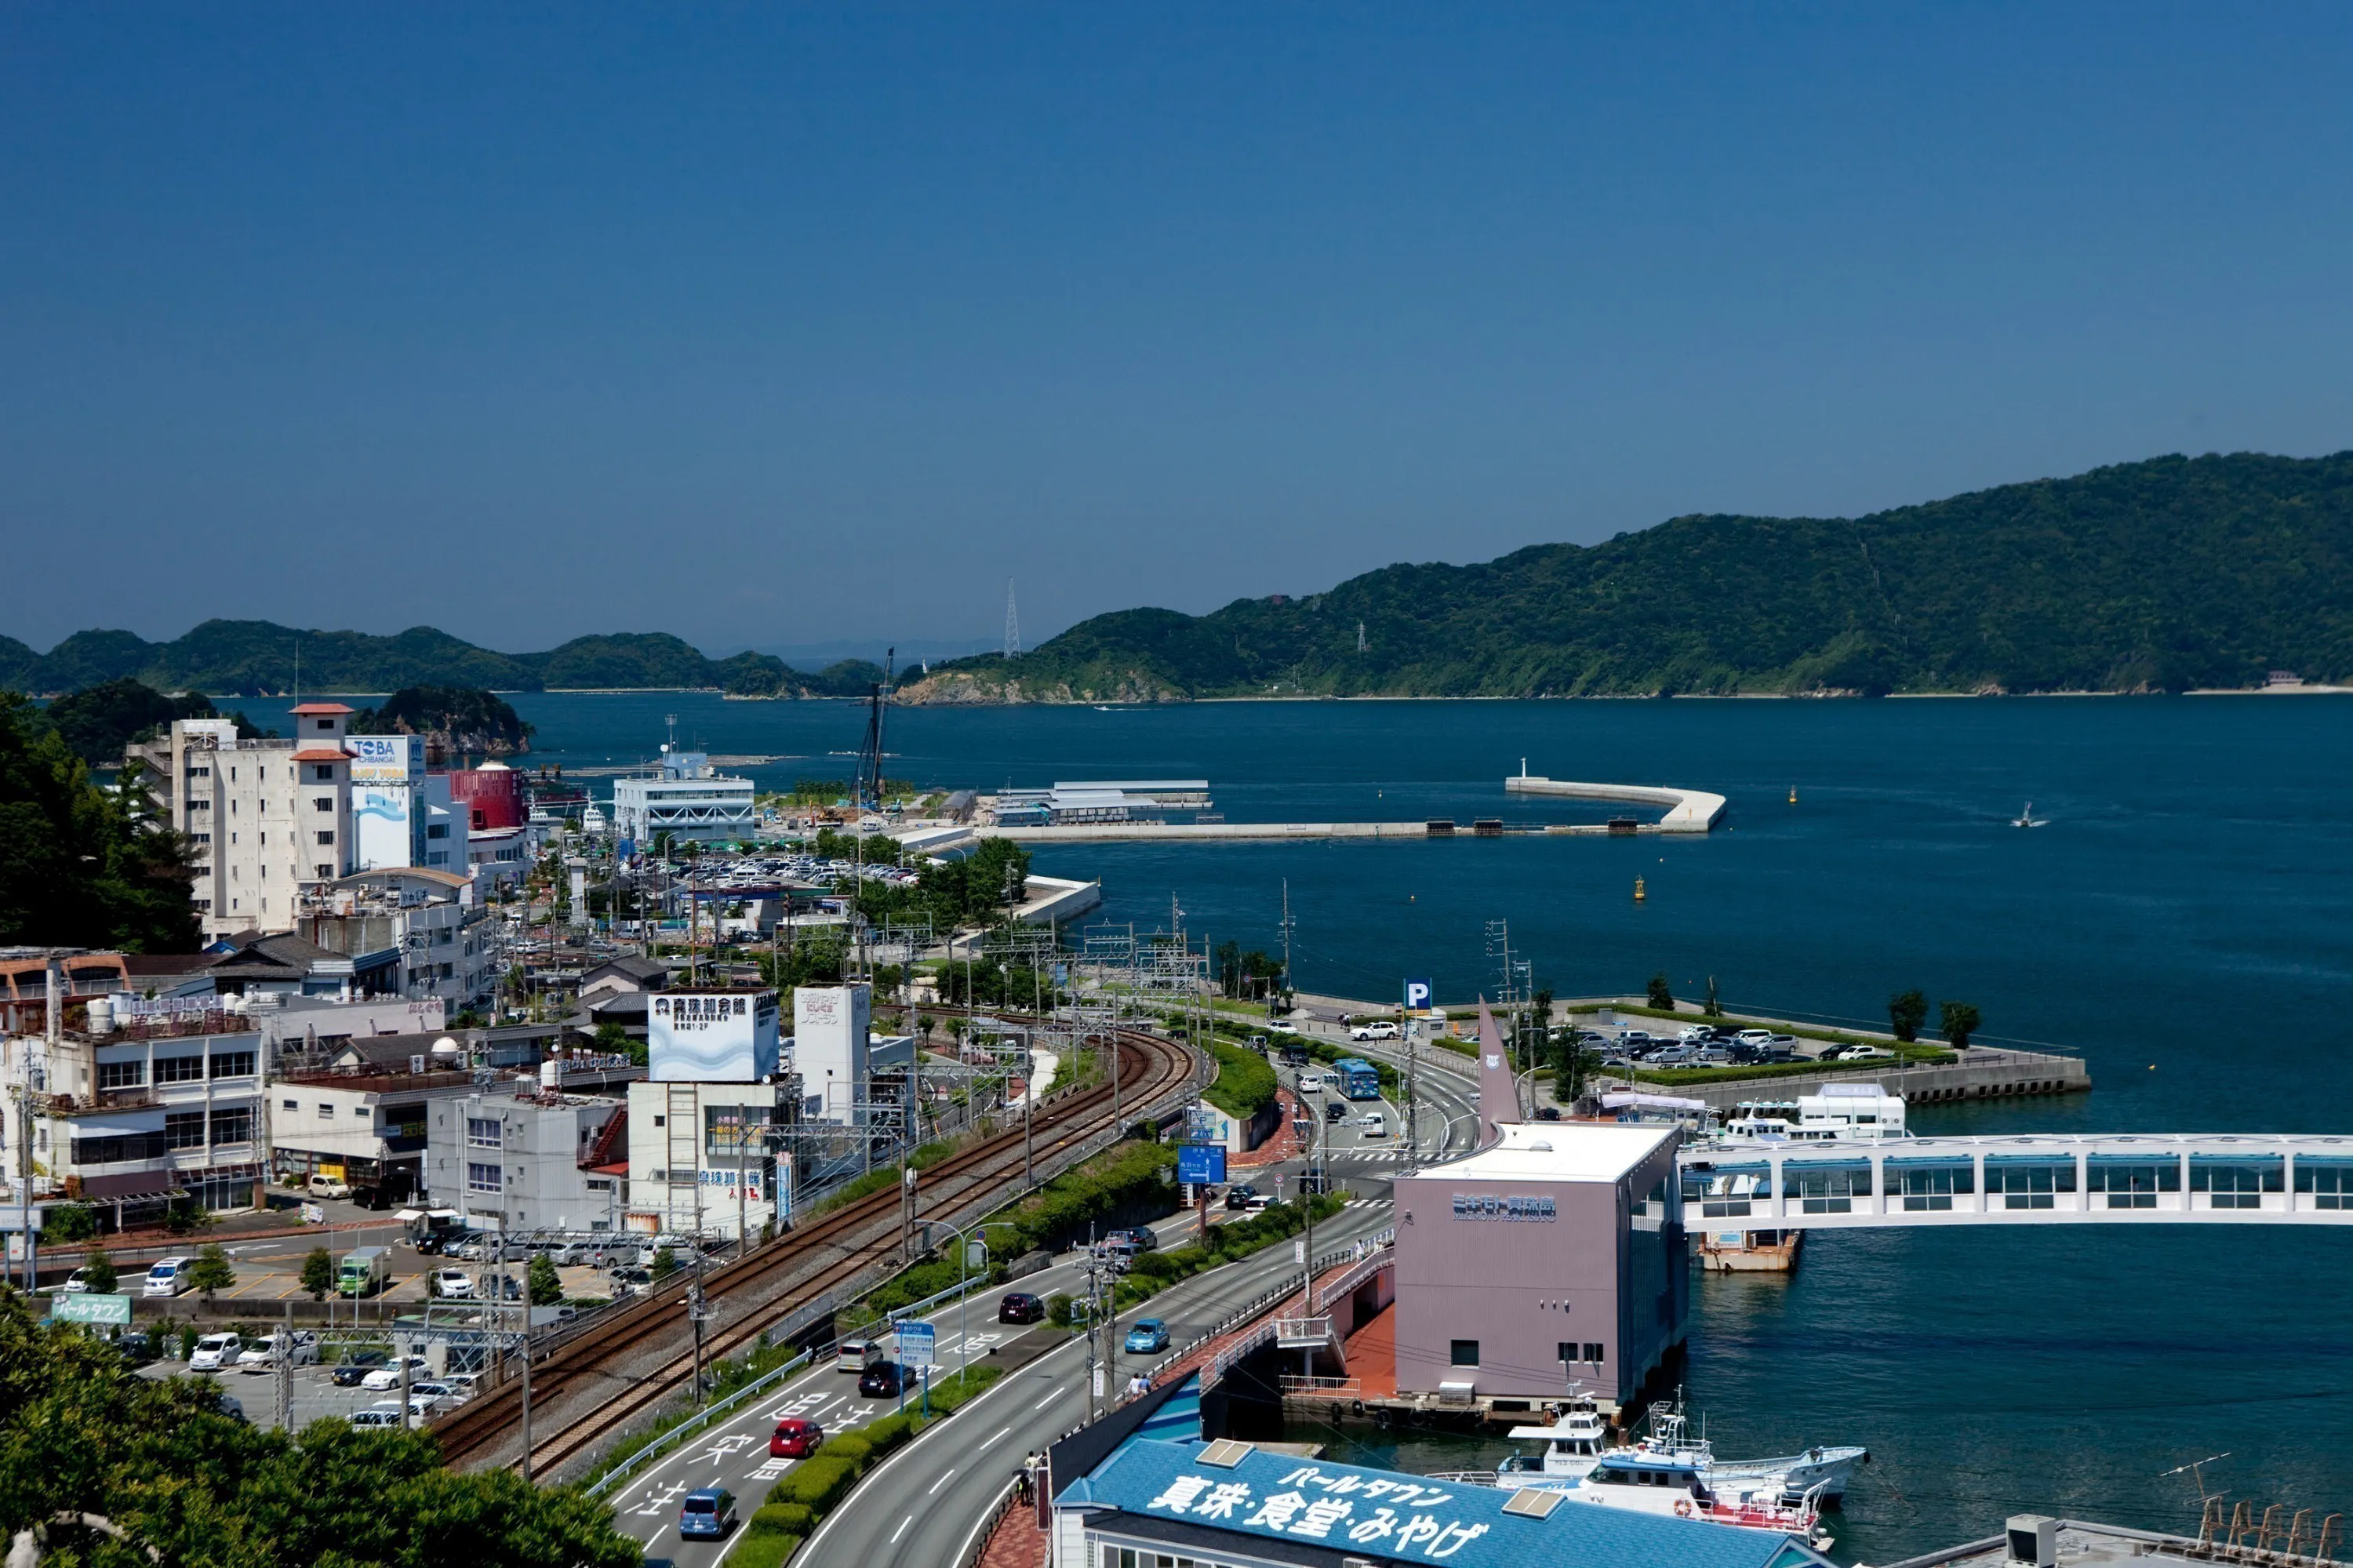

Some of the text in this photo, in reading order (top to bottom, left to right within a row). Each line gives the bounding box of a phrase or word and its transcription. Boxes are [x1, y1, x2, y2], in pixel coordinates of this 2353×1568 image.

[355, 740, 395, 755] TOBA
[1409, 984, 1429, 1006] P
[673, 998, 746, 1016] 真珠卸会館
[699, 1170, 760, 1186] 真珠卸館
[1453, 1194, 1556, 1213] ミキモト真珠島
[1453, 1212, 1500, 1222] MIKIMOTO
[1277, 1467, 1453, 1507] パールタウン
[1147, 1475, 1489, 1558] 真珠・食堂・みやげ
